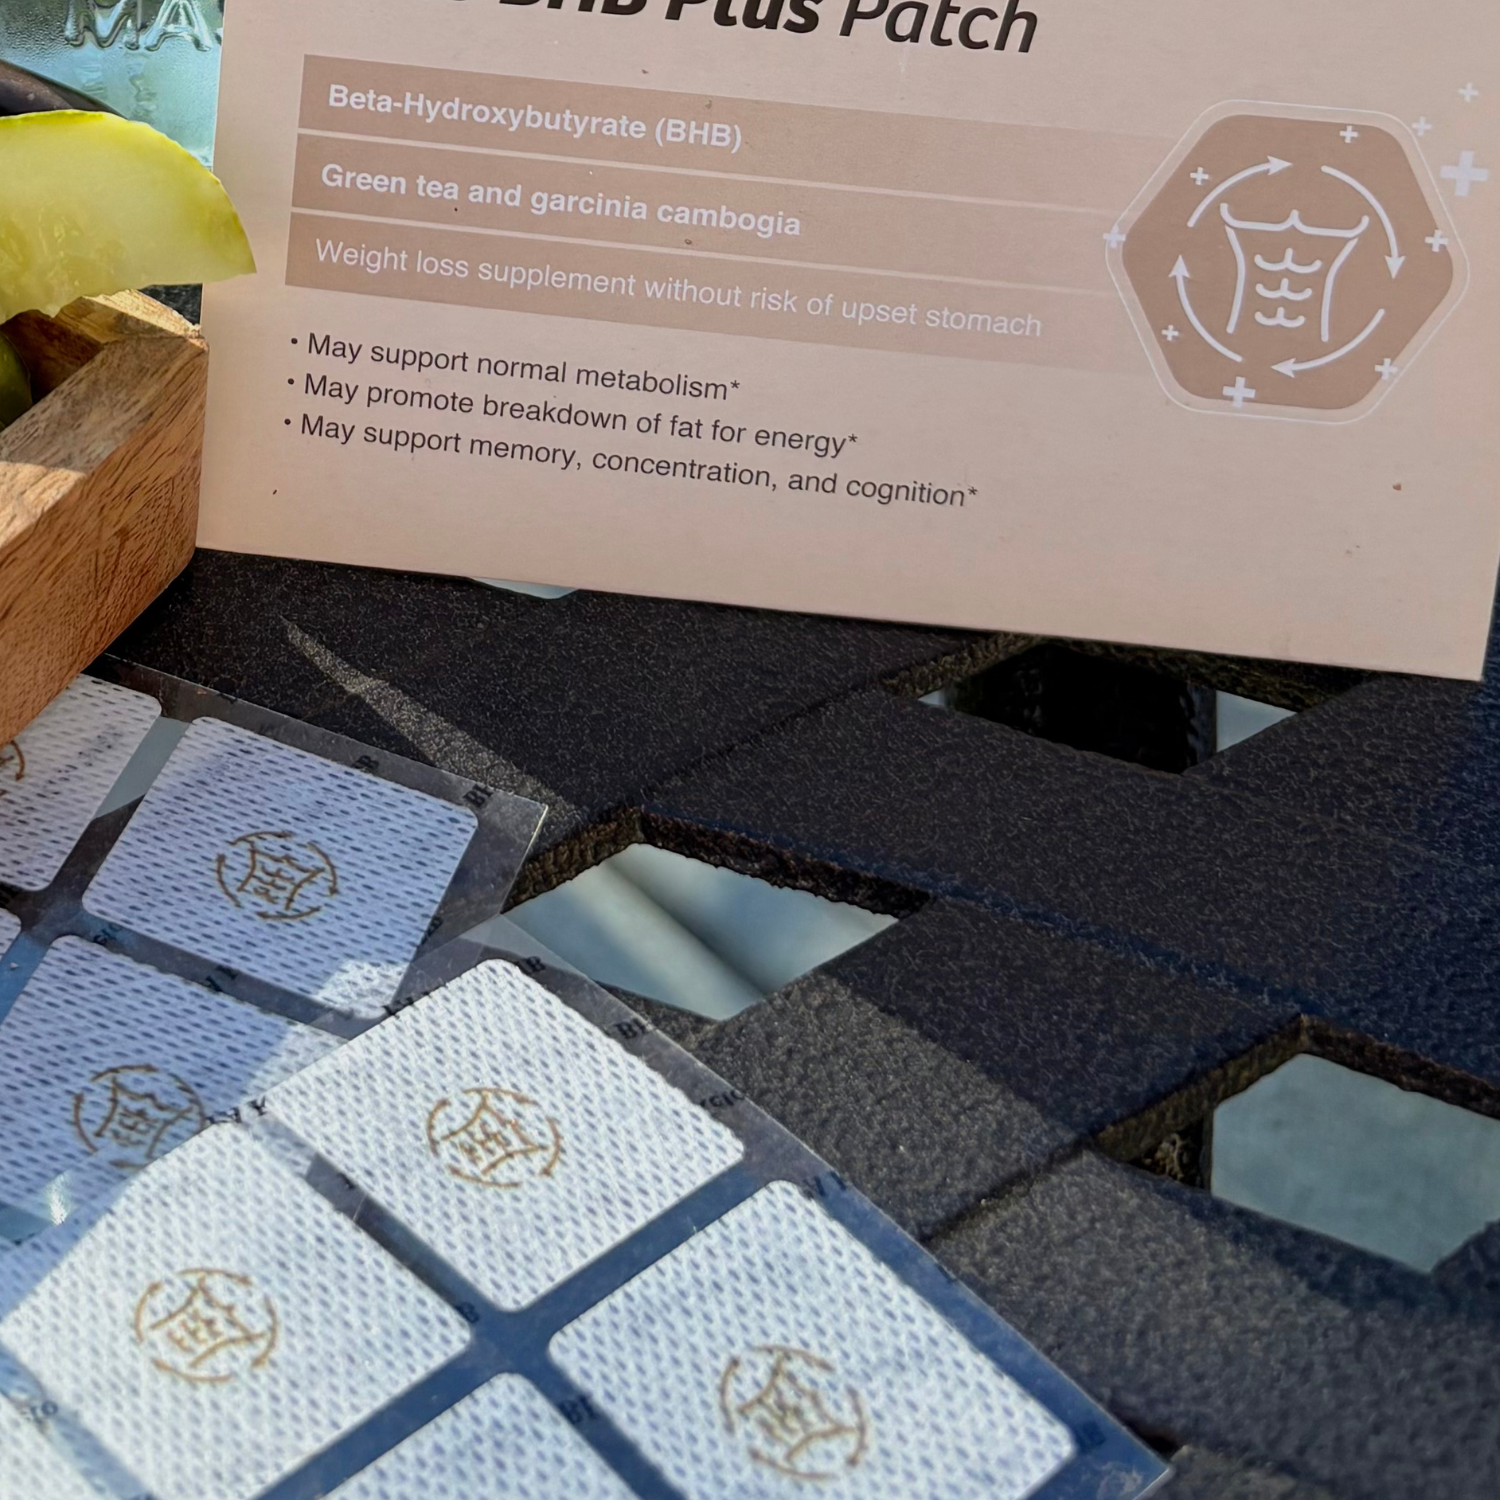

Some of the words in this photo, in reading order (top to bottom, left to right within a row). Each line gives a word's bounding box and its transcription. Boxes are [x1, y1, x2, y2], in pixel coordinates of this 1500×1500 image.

[328, 83, 647, 139] Beta-Hydroxybutyrate
[655, 117, 742, 154] (BHB)
[321, 163, 407, 198] Green
[415, 174, 460, 201] tea
[467, 179, 522, 208] and
[530, 189, 648, 222] garcinia
[656, 199, 801, 239] cambogia
[315, 237, 409, 275] Weight
[416, 249, 470, 279] loss
[477, 262, 637, 297] supplement
[644, 276, 743, 308] without
[750, 286, 799, 313] risk
[806, 293, 835, 317] of
[841, 300, 919, 326] upset
[925, 306, 1042, 337] stomach
[307, 332, 363, 365] May
[370, 345, 470, 374] support
[476, 357, 567, 384] normal
[304, 372, 360, 406] May
[366, 385, 474, 414] promote
[482, 393, 627, 431] breakdown
[636, 412, 663, 435] of
[669, 414, 704, 440] fat
[711, 418, 748, 444] for
[301, 412, 356, 446] May
[363, 426, 462, 454] support
[469, 438, 582, 471] memory,
[592, 452, 777, 492] concentration,
[787, 472, 838, 494] and
